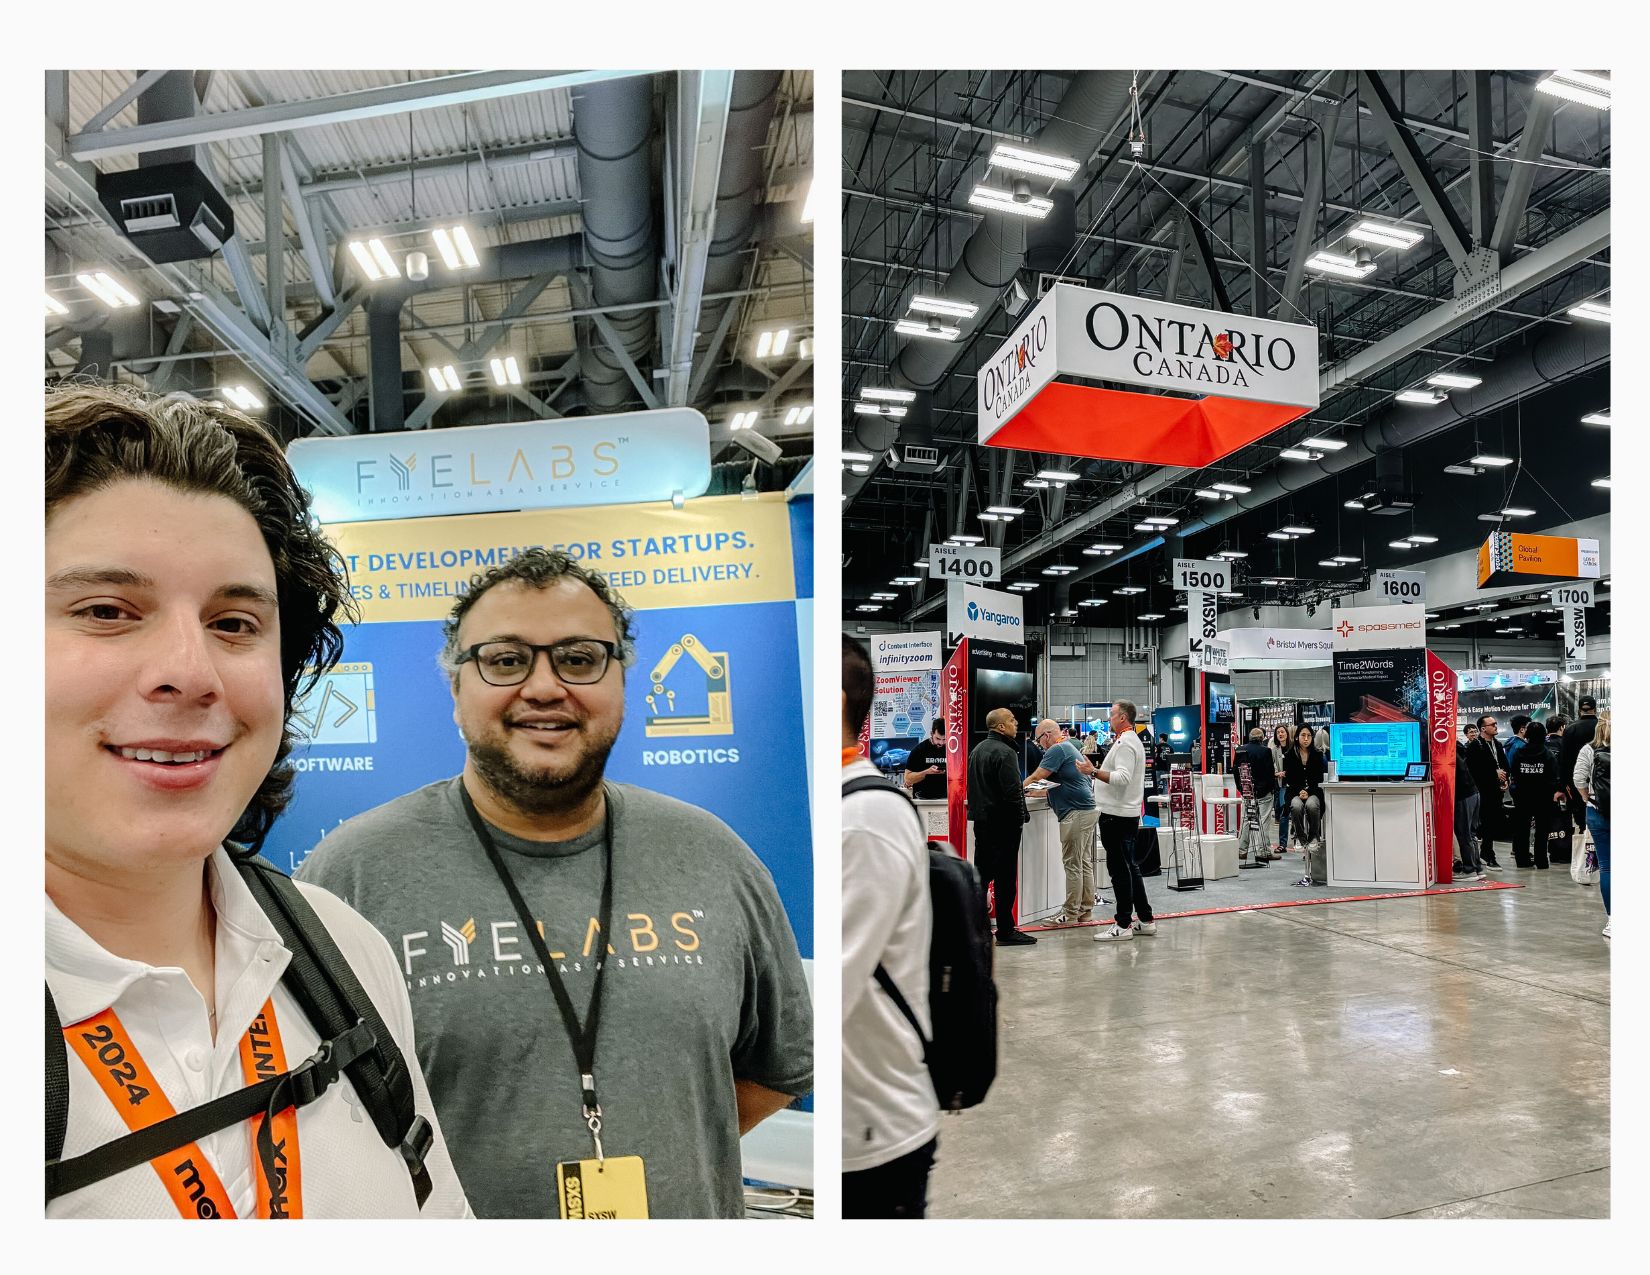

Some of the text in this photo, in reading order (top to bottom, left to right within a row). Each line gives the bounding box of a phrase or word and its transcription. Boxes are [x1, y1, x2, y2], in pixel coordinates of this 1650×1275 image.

[1086, 302, 1296, 376] ONTARIO
[984, 315, 1047, 411] ONTARIO
[1133, 351, 1249, 388] CANADA
[995, 371, 1031, 420] CANADA
[356, 441, 619, 494] FYELABS
[357, 490, 473, 506] INNOVATION
[487, 488, 505, 496] AS
[537, 479, 621, 492] SERVICE
[611, 531, 755, 558] STARTUPS.
[934, 547, 957, 555] AISLE
[1518, 545, 1538, 553] Global
[938, 557, 993, 578] 1400
[1518, 554, 1542, 563] Pavilion
[379, 584, 391, 599] &
[653, 562, 760, 585] DELIVERY.
[1181, 570, 1225, 588] 1500
[1379, 571, 1396, 579] AISLE
[1382, 580, 1421, 597] 1600
[1557, 589, 1589, 604] 1700
[980, 607, 1020, 626] Yangaroo
[1202, 592, 1217, 639] SXSW
[1358, 619, 1421, 633] spassmed
[1574, 607, 1586, 648] SXSW
[908, 641, 933, 649] Interface
[1276, 640, 1297, 649] Bristol
[1297, 641, 1318, 651] Myers
[879, 653, 933, 666] infinityzoom
[1336, 659, 1394, 670] Time2Words
[876, 675, 922, 684] ZoomViewer
[874, 687, 904, 695] Solution
[947, 664, 959, 753] ONTARIO
[1433, 670, 1449, 743] ONTARIO
[1446, 687, 1455, 728] CANADA
[1472, 706, 1484, 714] Easy
[1484, 705, 1500, 713] Motion
[1501, 704, 1521, 712] Capture
[1529, 702, 1551, 710] Training
[642, 748, 740, 766] ROBOTICS
[560, 963, 582, 973] AS
[618, 955, 704, 968] SERVICE
[81, 1024, 151, 1106] 2024
